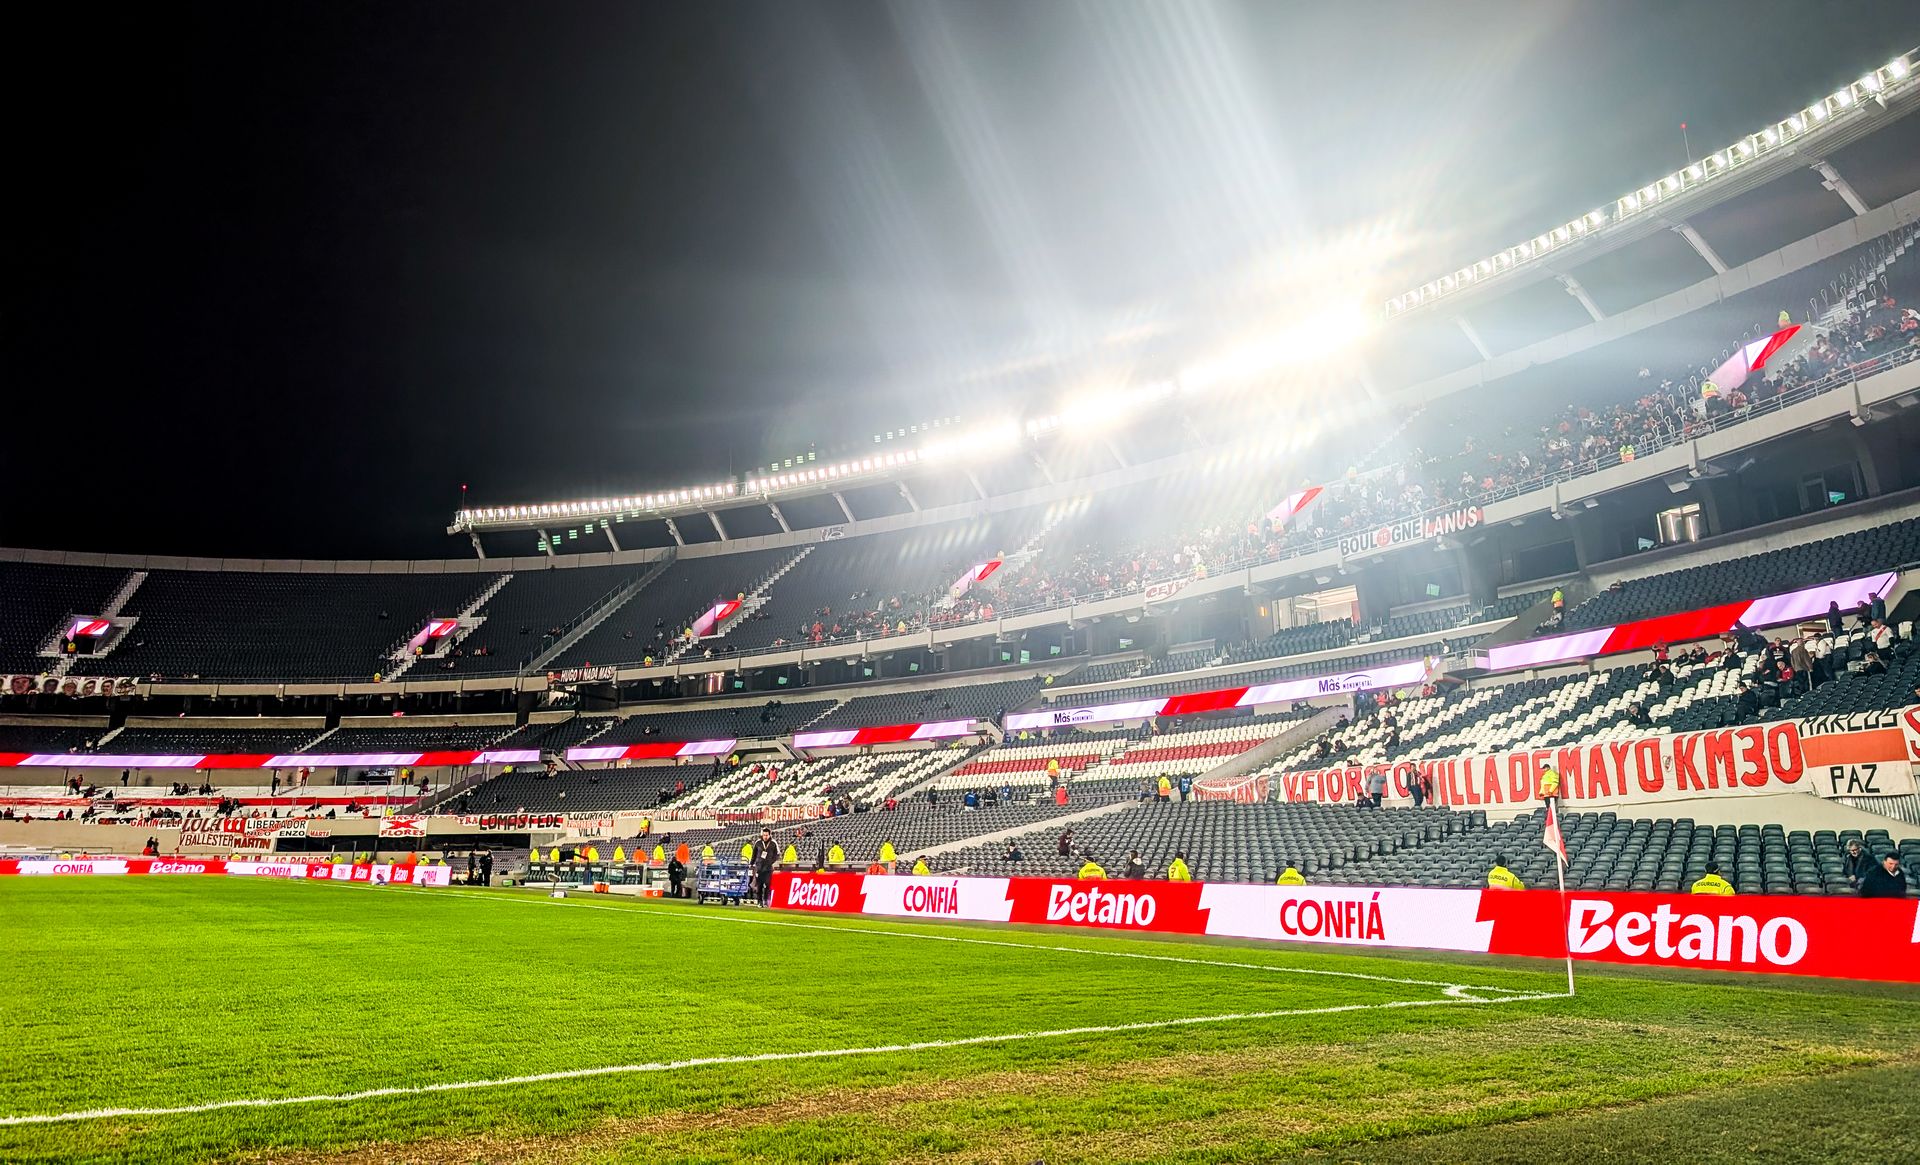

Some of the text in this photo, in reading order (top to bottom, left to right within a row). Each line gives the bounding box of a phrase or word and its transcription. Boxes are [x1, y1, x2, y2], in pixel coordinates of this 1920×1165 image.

[1425, 505, 1478, 539] LANUS
[1558, 737, 1664, 800] MAYO
[1830, 764, 1881, 794] PAZ
[247, 819, 307, 829] LIBERTADOR
[579, 828, 601, 837] VILLA
[233, 838, 271, 849] MARTIN
[148, 861, 206, 874] Betano
[787, 877, 840, 907] Betano
[903, 879, 958, 915] CONFIÁ
[1047, 884, 1156, 927] Betano
[1280, 891, 1385, 940] CONFIÁ
[1568, 899, 1809, 966] Betano
